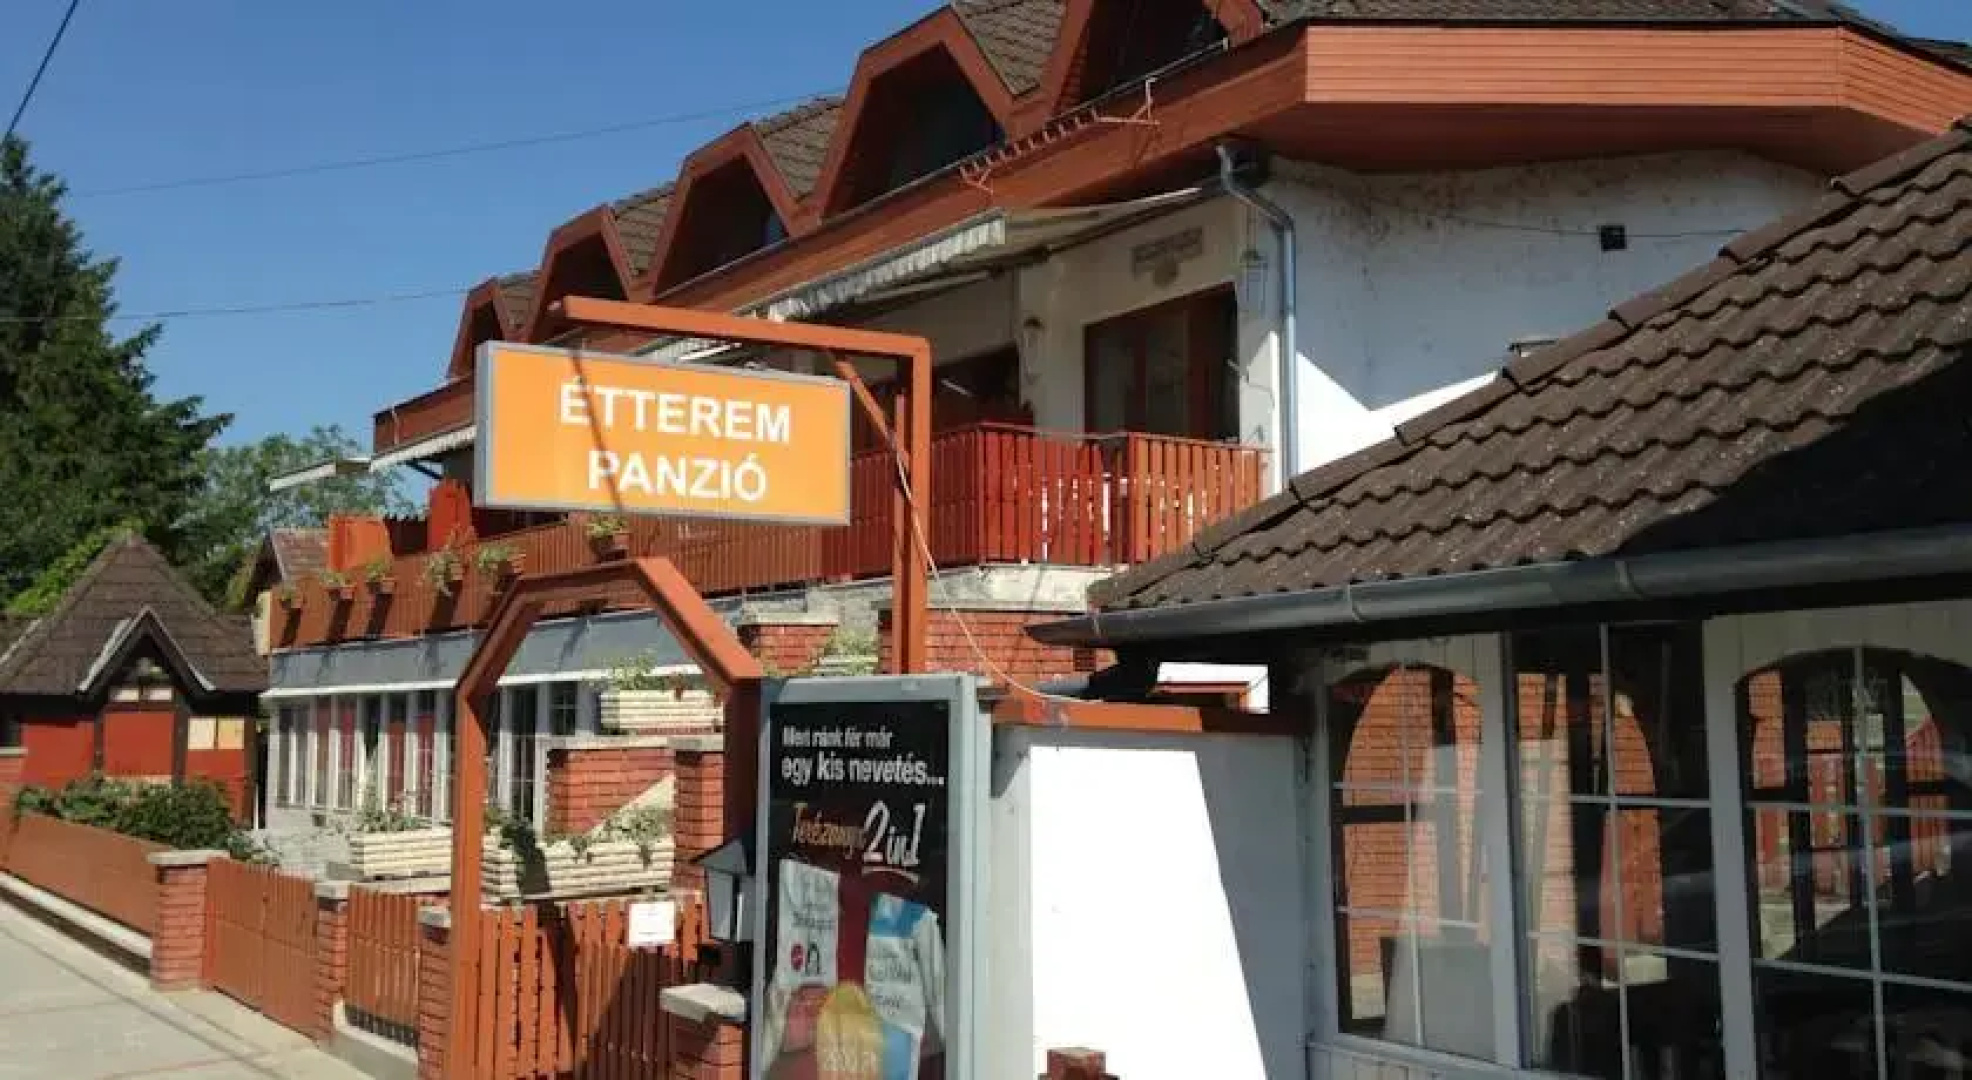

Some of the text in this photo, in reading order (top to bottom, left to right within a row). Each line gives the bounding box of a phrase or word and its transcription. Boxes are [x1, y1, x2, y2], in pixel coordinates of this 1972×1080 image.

[560, 376, 791, 444] ÉTTEREM
[587, 449, 767, 502] PANZIÓ
[782, 756, 813, 785] egy
[817, 751, 845, 781] kis
